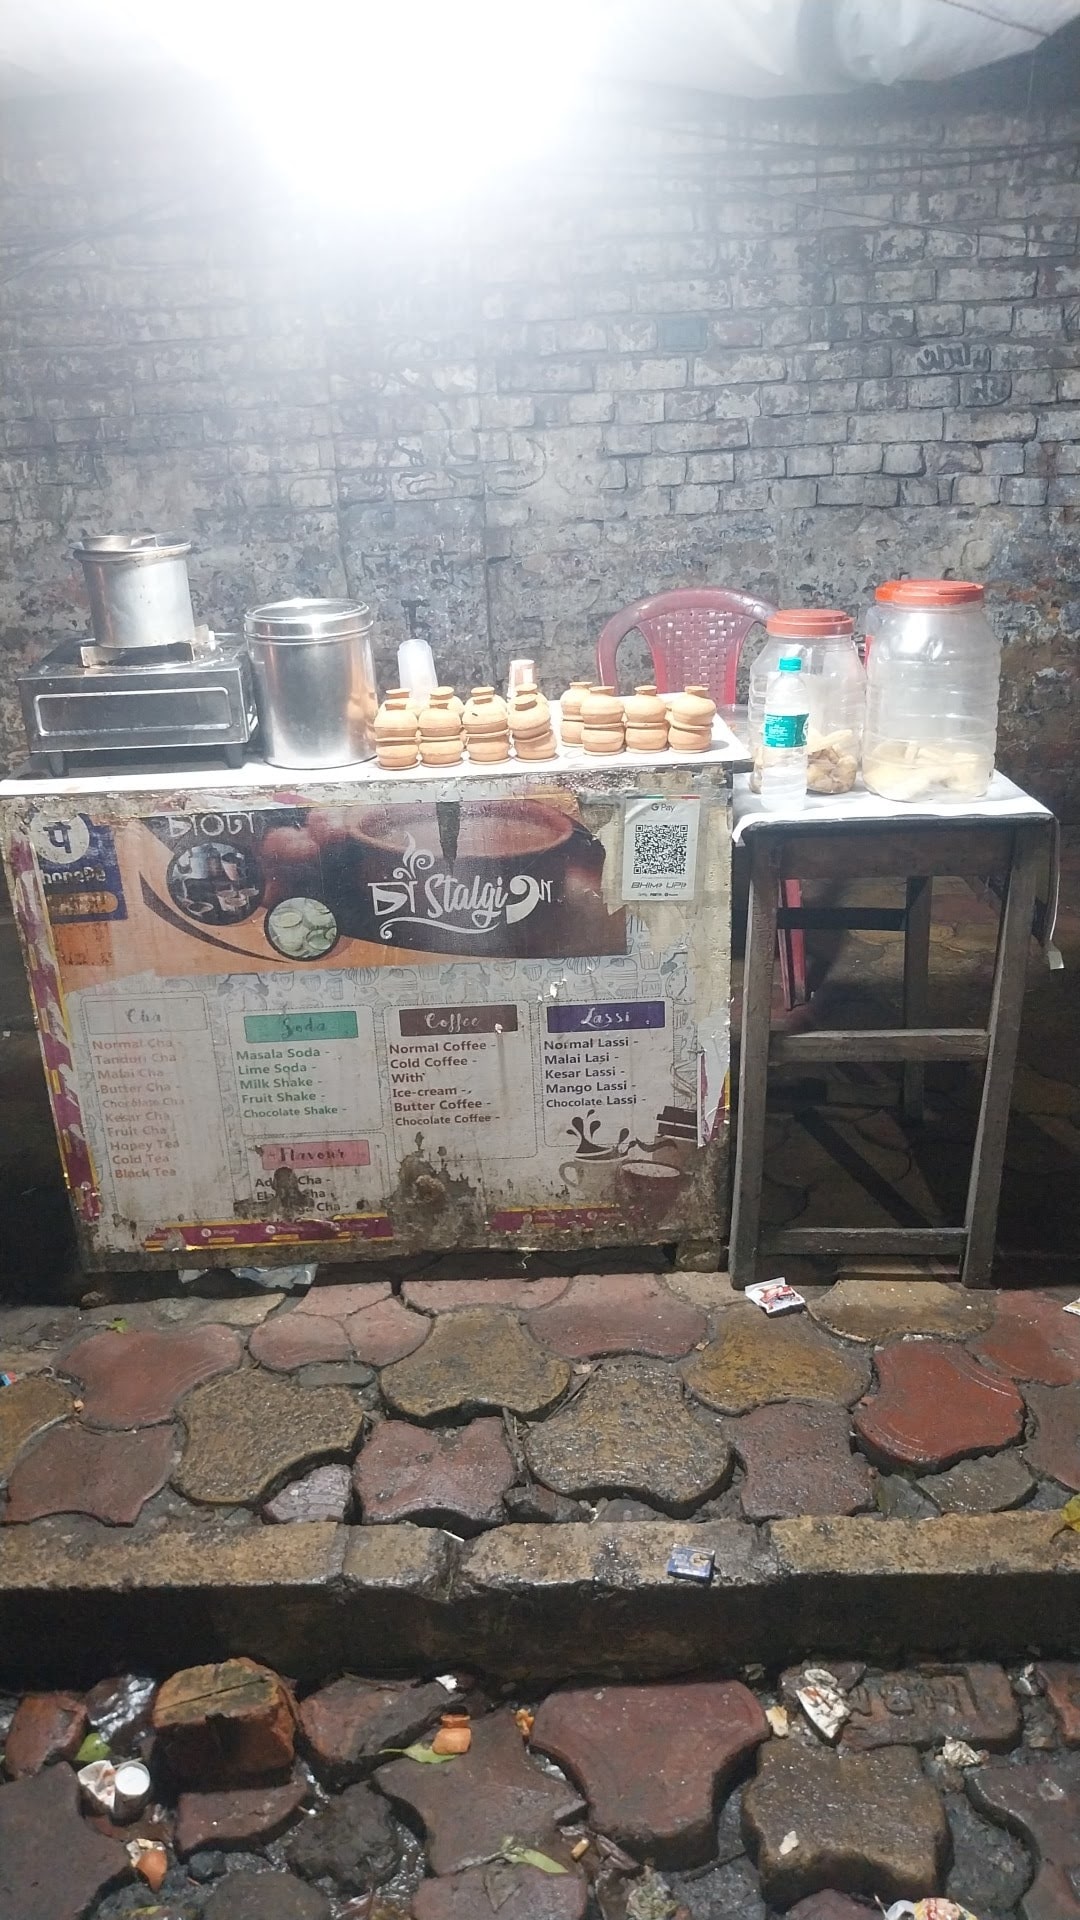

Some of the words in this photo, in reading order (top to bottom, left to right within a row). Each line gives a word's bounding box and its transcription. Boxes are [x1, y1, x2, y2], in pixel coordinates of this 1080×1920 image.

[661, 803, 675, 812] Pay
[425, 1013, 480, 1032] Coffee
[580, 1007, 630, 1028] Lassi
[281, 1016, 326, 1039] Soda
[92, 1039, 142, 1050] Normal
[147, 1038, 173, 1048] Cha
[389, 1043, 439, 1054] Normal
[443, 1040, 487, 1051] Coffee
[544, 1038, 593, 1050] Normal
[598, 1036, 629, 1047] Lassi
[151, 1052, 177, 1062] Cha
[236, 1049, 283, 1060] Masala
[287, 1047, 321, 1058] Soda
[544, 1053, 581, 1065] Malai
[585, 1052, 610, 1063] Lasi
[238, 1065, 270, 1075] Lime
[274, 1062, 307, 1073] Soda
[390, 1058, 420, 1069] Cold
[424, 1056, 468, 1067] Coffee
[139, 1066, 164, 1078] Cha
[391, 1072, 423, 1083] With
[545, 1069, 581, 1079] Kesar
[585, 1066, 616, 1077] Lassi
[100, 1083, 142, 1094] Butter
[146, 1081, 171, 1092] Cha
[240, 1078, 270, 1089] Milk
[273, 1077, 313, 1088] Shake
[546, 1083, 593, 1095] Mango
[596, 1080, 628, 1091] Lassi
[241, 1093, 273, 1103] Fruit
[276, 1091, 317, 1102] Shake
[392, 1087, 457, 1098] Ice-cream
[394, 1102, 435, 1112] Butter
[439, 1099, 482, 1110] Coffee
[546, 1097, 602, 1108] Chocolate
[606, 1094, 637, 1105] Lassi
[145, 1111, 170, 1121] Cha
[243, 1108, 300, 1118] Chocolate
[303, 1105, 338, 1115] Shake
[395, 1115, 451, 1126] Chocolate
[454, 1113, 491, 1123] Coffee
[106, 1126, 139, 1137] Fruit
[142, 1125, 167, 1135] Cha
[156, 1139, 180, 1149] Tea
[112, 1154, 143, 1165] Cold
[146, 1153, 170, 1163] Tea
[114, 1168, 150, 1179] Black
[152, 1167, 177, 1177] Tea
[298, 1175, 322, 1185] Cha
[304, 1189, 326, 1198] ha
[316, 1202, 341, 1212] Cha
